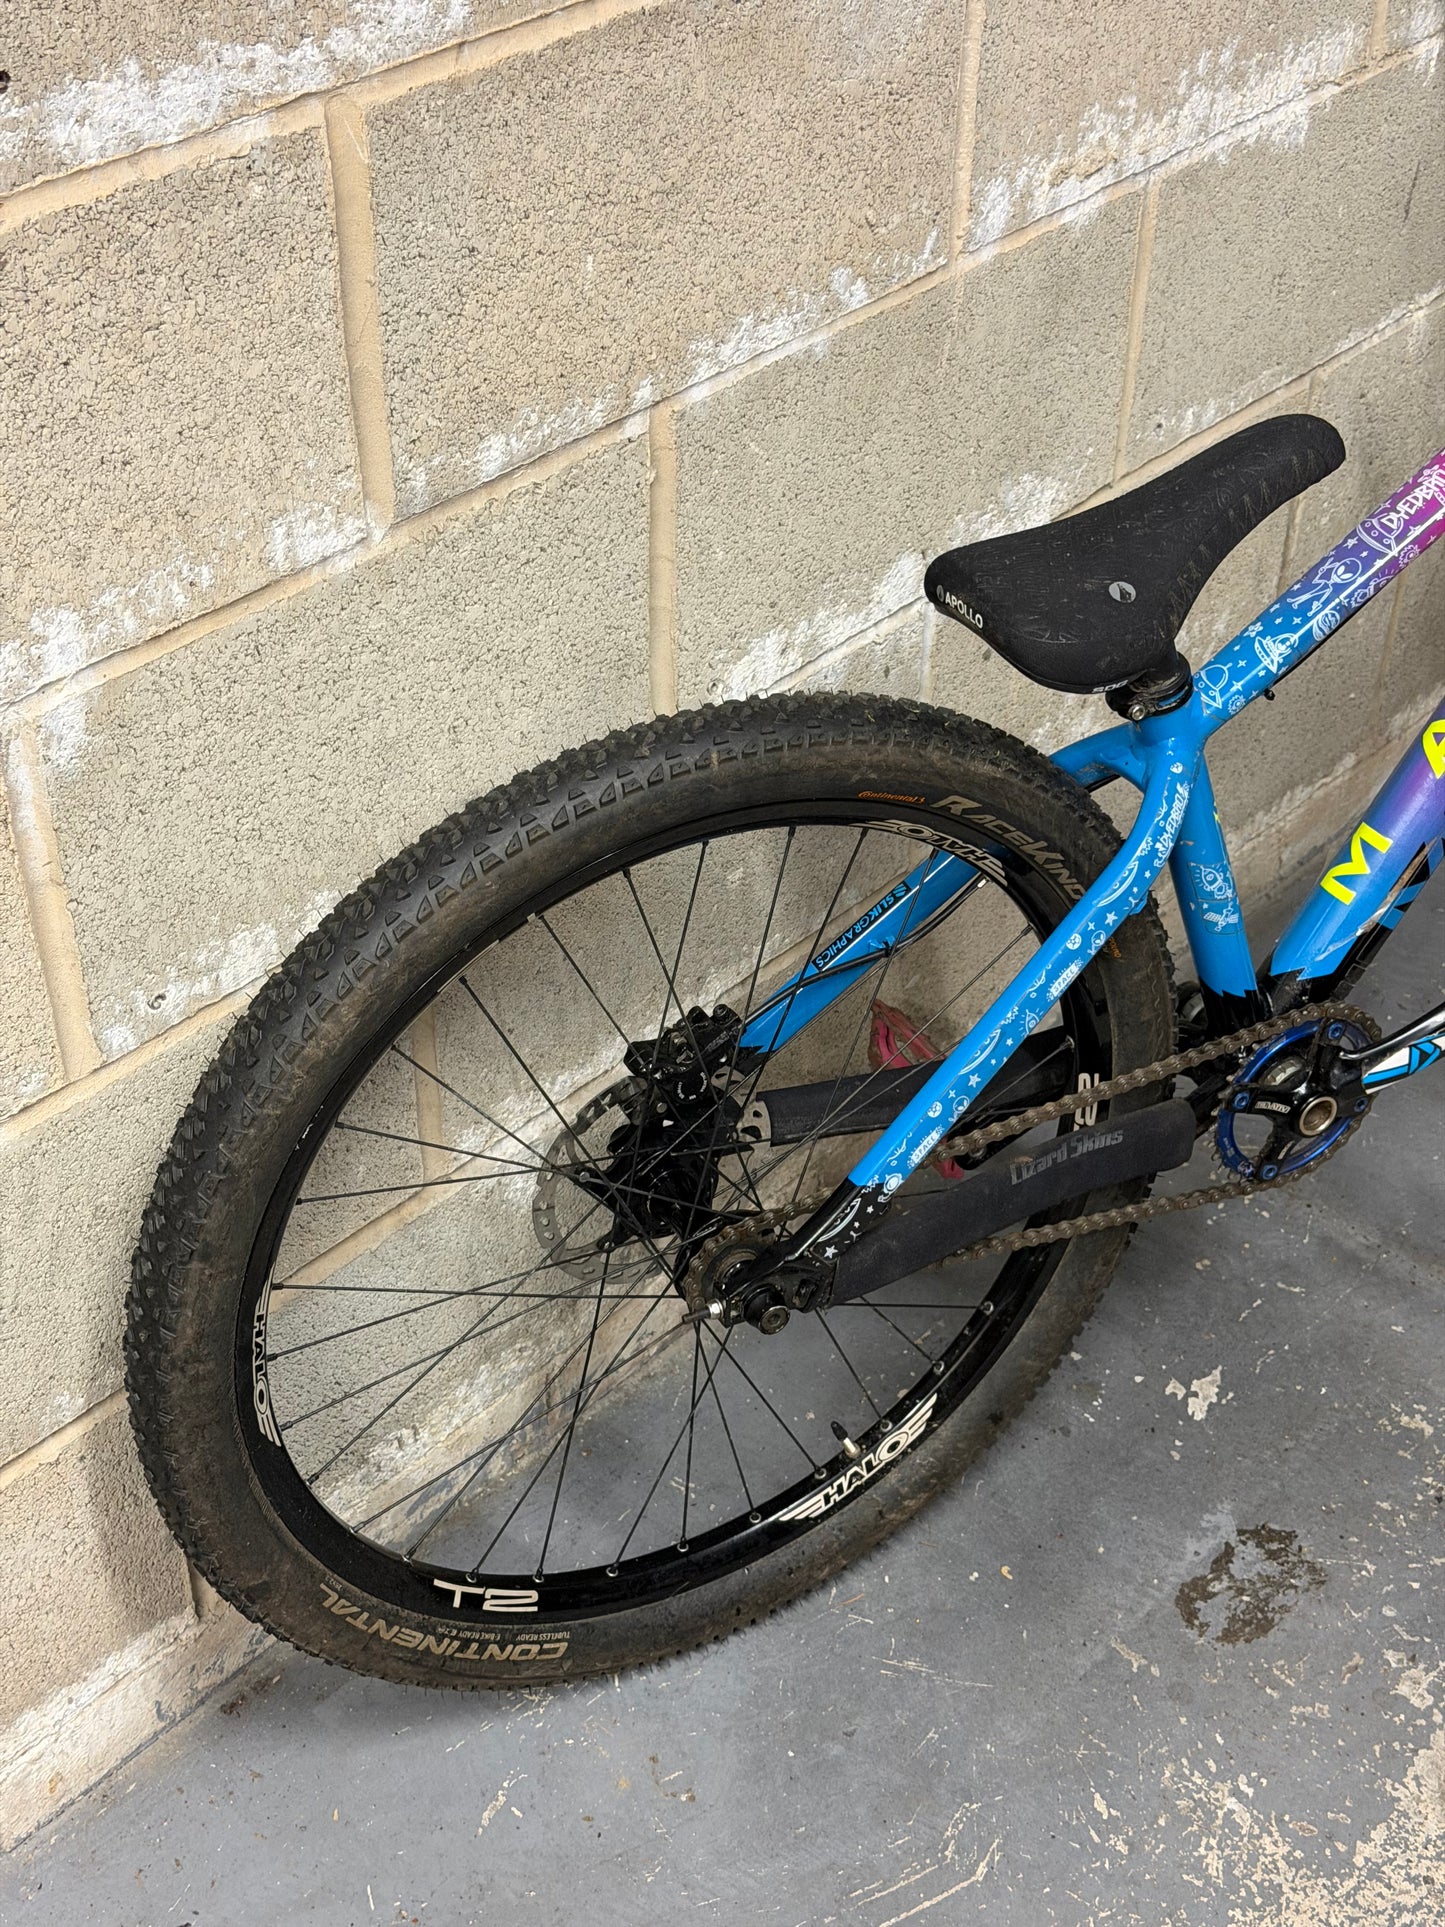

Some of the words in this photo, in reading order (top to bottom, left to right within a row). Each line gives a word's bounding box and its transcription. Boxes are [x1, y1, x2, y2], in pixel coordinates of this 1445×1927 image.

[945, 591, 984, 629] APOLLO
[1052, 966, 1077, 993] SPACE
[912, 1134, 937, 1160] SPACE
[1010, 1142, 1067, 1185] Lizard
[1070, 1129, 1124, 1158] Skins
[433, 1579, 539, 1612] T2
[319, 1582, 569, 1661] CONTINENTAL
[457, 1629, 480, 1640] READY
[515, 1633, 539, 1641] READY
[538, 1631, 571, 1641] TUBELESS
